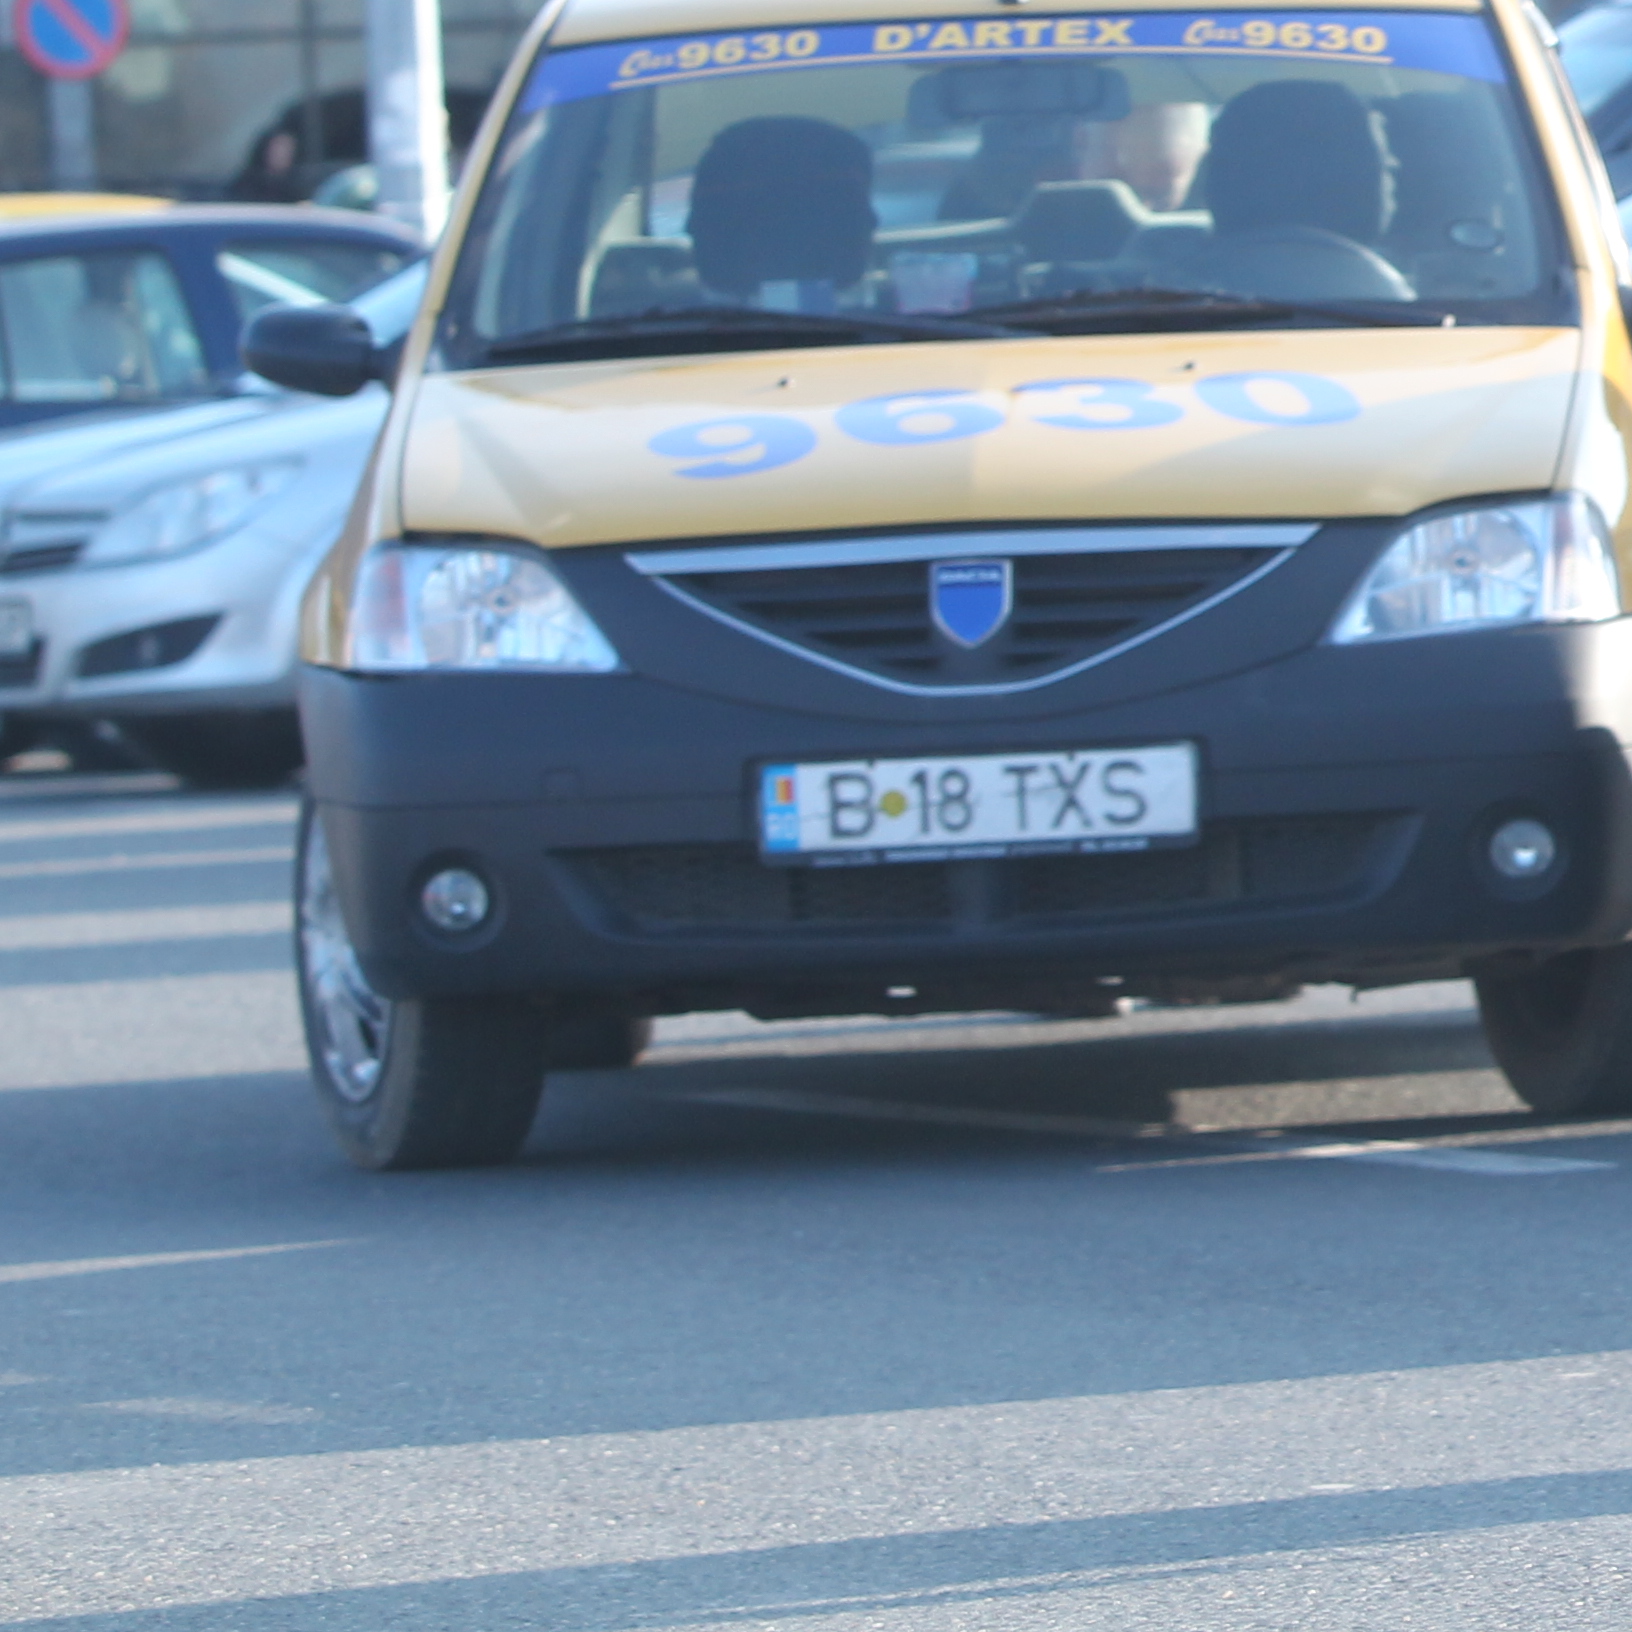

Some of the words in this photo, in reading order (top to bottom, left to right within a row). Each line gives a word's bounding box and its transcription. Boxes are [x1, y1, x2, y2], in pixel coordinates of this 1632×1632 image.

[676, 29, 821, 69] 9630
[872, 18, 1136, 53] D'ARTEX
[1241, 19, 1389, 55] 9630
[646, 370, 1363, 480] 9630
[825, 771, 878, 840] B
[910, 768, 975, 835] 18
[1002, 760, 1149, 832] TXS
